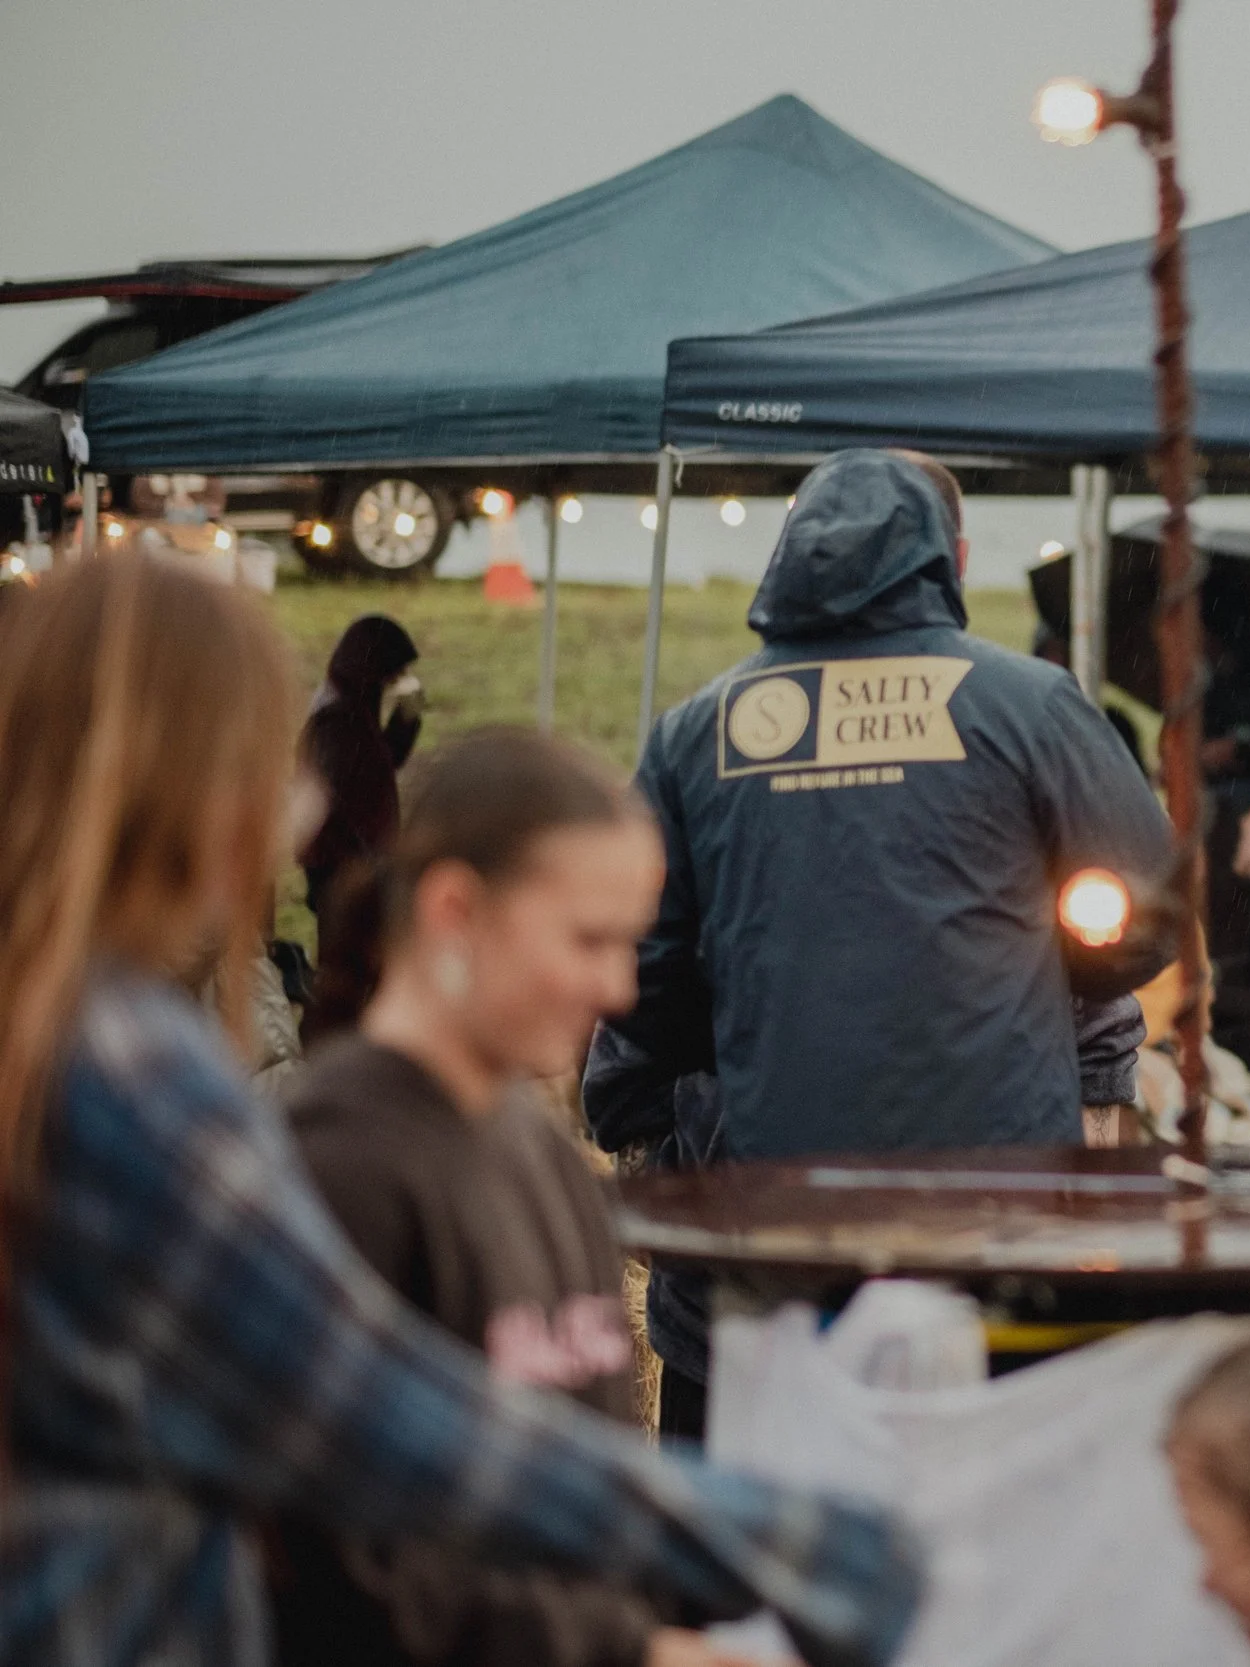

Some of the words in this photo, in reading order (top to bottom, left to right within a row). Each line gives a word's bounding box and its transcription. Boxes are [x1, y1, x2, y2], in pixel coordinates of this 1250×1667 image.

[718, 401, 803, 423] CLASSIC
[837, 673, 940, 707] SALTY
[835, 711, 935, 745] CREW
